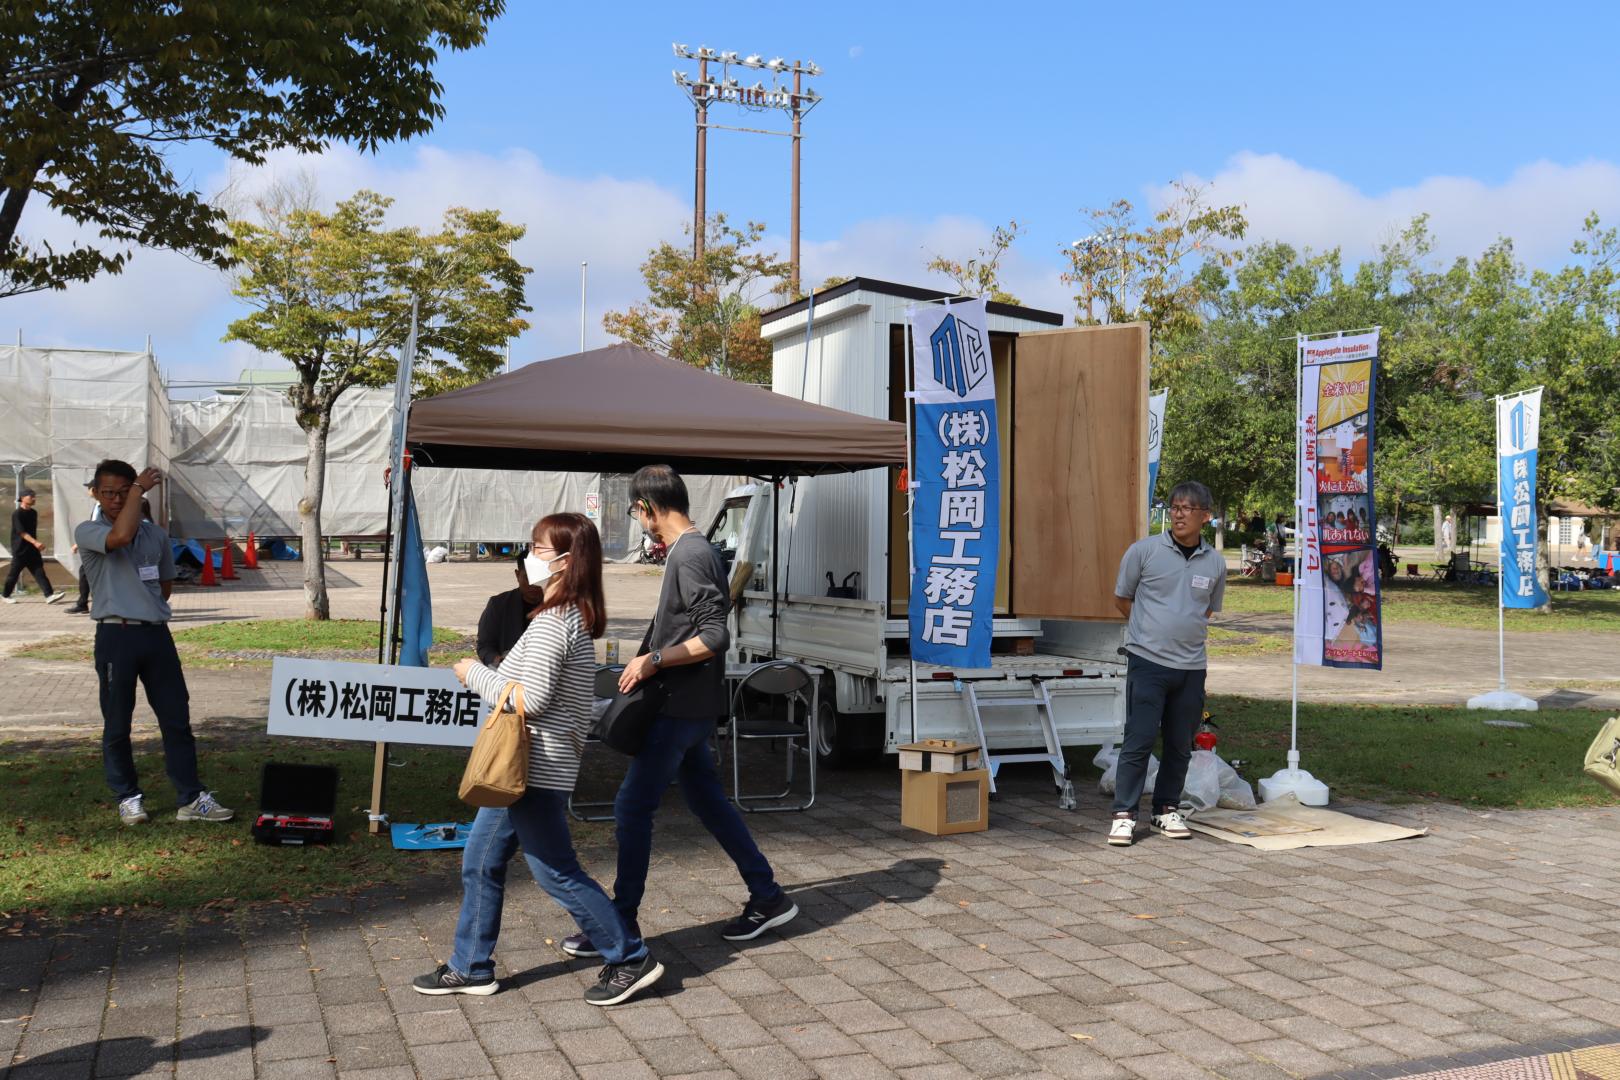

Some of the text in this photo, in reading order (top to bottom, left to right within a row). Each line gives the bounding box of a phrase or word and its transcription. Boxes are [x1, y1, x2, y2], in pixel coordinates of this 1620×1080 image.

[921, 410, 990, 647] (株)松岡工務店
[284, 677, 482, 728] (株)松岡工務店
